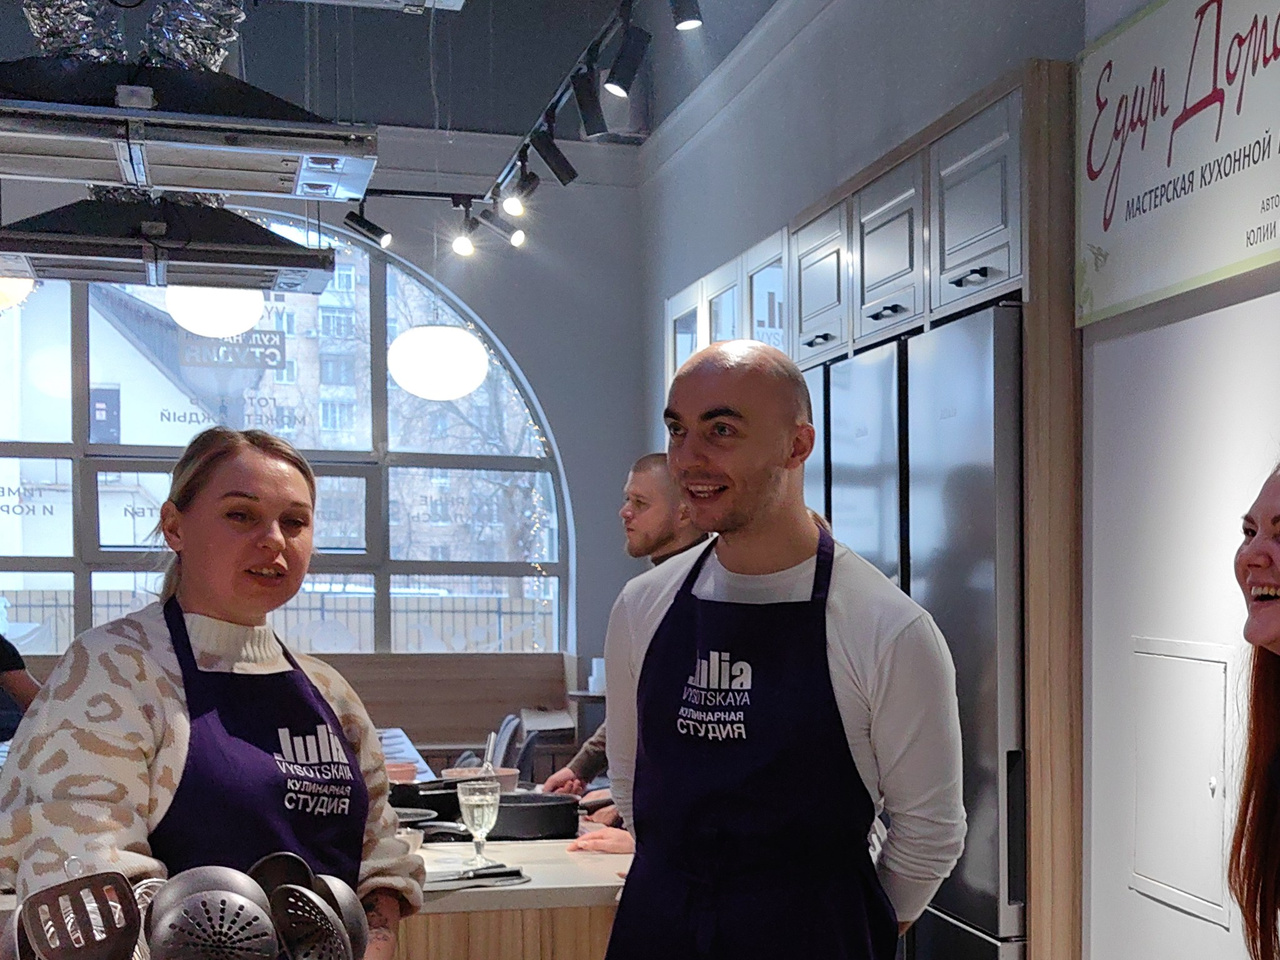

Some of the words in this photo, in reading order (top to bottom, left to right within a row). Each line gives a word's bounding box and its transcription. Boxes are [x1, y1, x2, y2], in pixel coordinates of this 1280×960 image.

[1125, 170, 1195, 222] МАСТЕРСКАЯ
[1199, 131, 1271, 189] КУХОННОЙ
[1246, 224, 1277, 248] ЮЛИИ
[677, 718, 747, 741] СТУДИЯ
[276, 759, 354, 780] VYSOTSKAYA
[287, 778, 352, 797] КУЛИНАРНАЯ
[284, 792, 351, 816] СТУДИЯ
